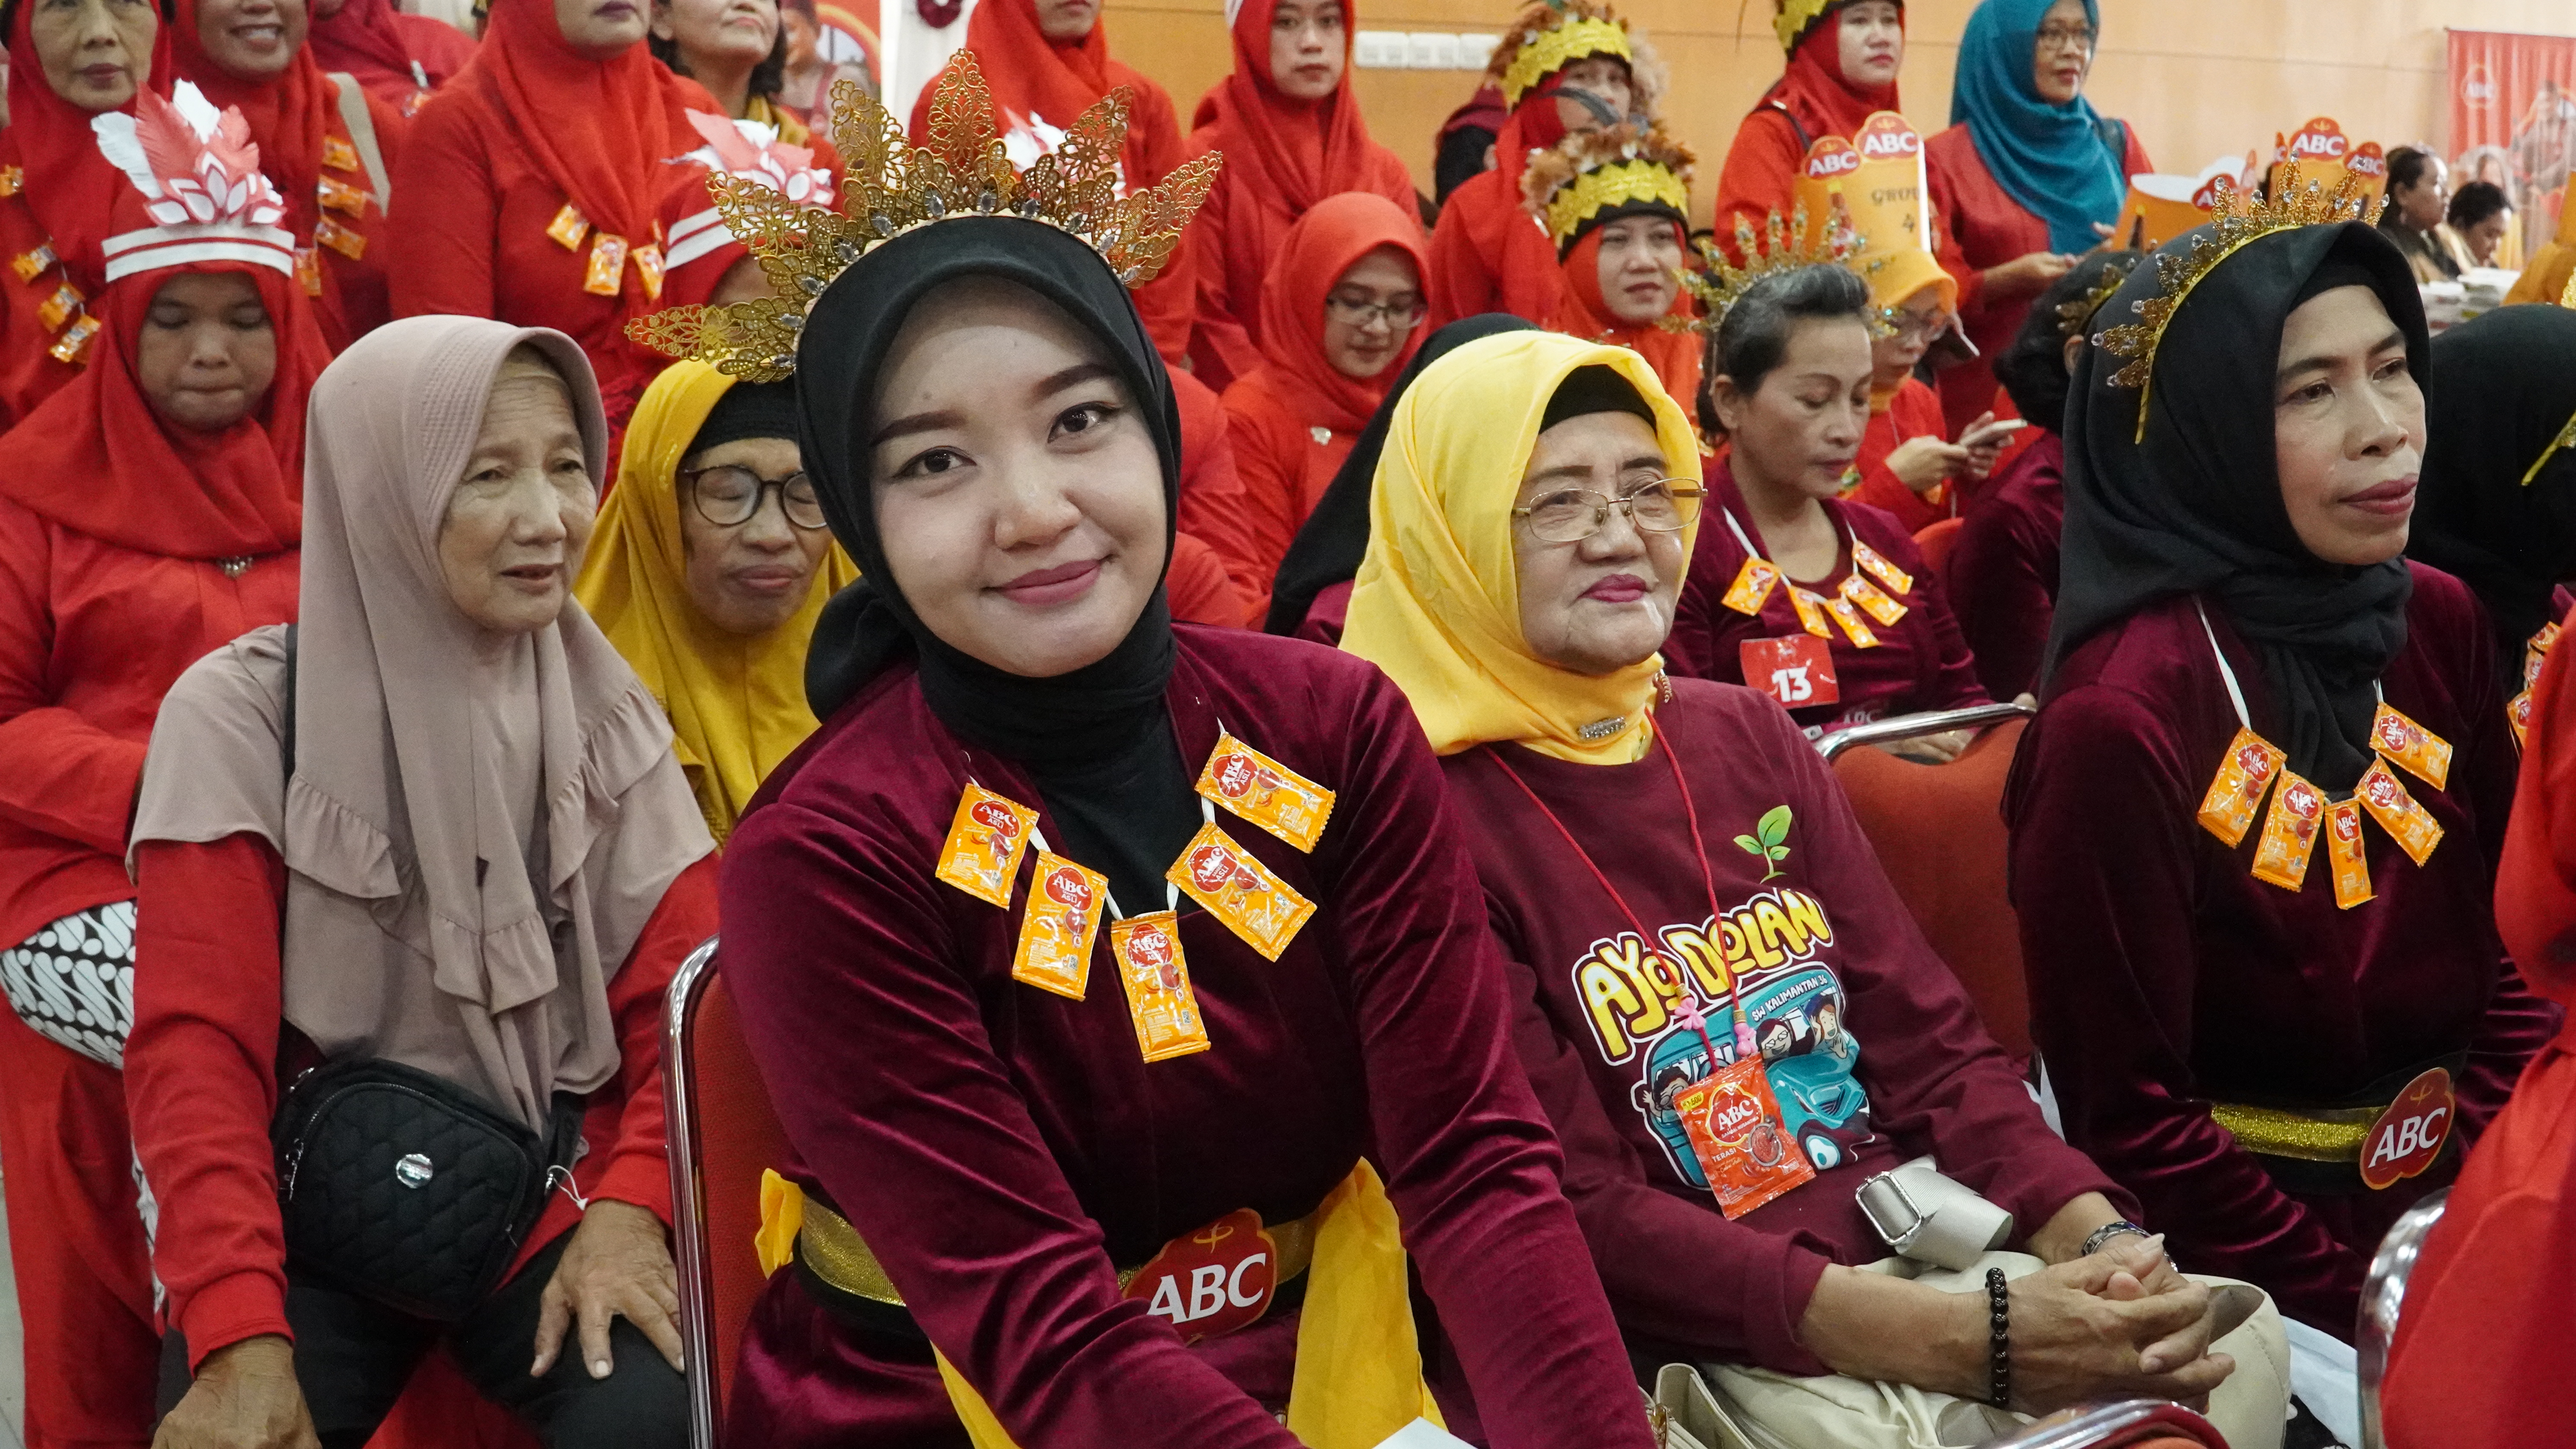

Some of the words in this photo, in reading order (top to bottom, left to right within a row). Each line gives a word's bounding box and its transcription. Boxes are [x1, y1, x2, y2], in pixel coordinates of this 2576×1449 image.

[1864, 131, 1919, 155] ABC
[2292, 133, 2345, 156] ABC
[1809, 151, 1859, 176] ABC
[1771, 666, 1812, 702] 13
[2385, 717, 2399, 746] ABC
[2244, 749, 2267, 772] ABC
[1221, 755, 1244, 791] ABC
[1240, 770, 1251, 786] ASLI
[2371, 775, 2388, 800] ABC
[978, 804, 1018, 828] ABC
[987, 818, 1004, 829] ASLI
[2337, 814, 2357, 831] ABC
[1197, 847, 1225, 883] ABC
[1212, 863, 1224, 877] SAMBAL
[1216, 865, 1229, 882] ASLI
[1052, 874, 1089, 897] ABC
[1061, 893, 1078, 903] ASLI
[1132, 933, 1167, 954] ABC
[1580, 938, 1682, 1057] AYO
[1666, 890, 1830, 995] DOLAN
[1751, 1005, 1767, 1022] SW
[1765, 976, 1819, 1012] KALIMANTAN
[1817, 974, 1828, 985] 36
[1718, 1100, 1753, 1131] ABC
[2367, 1107, 2447, 1169] ABC
[1711, 1147, 1737, 1163] TERASI
[1146, 1252, 1266, 1325] ABC
